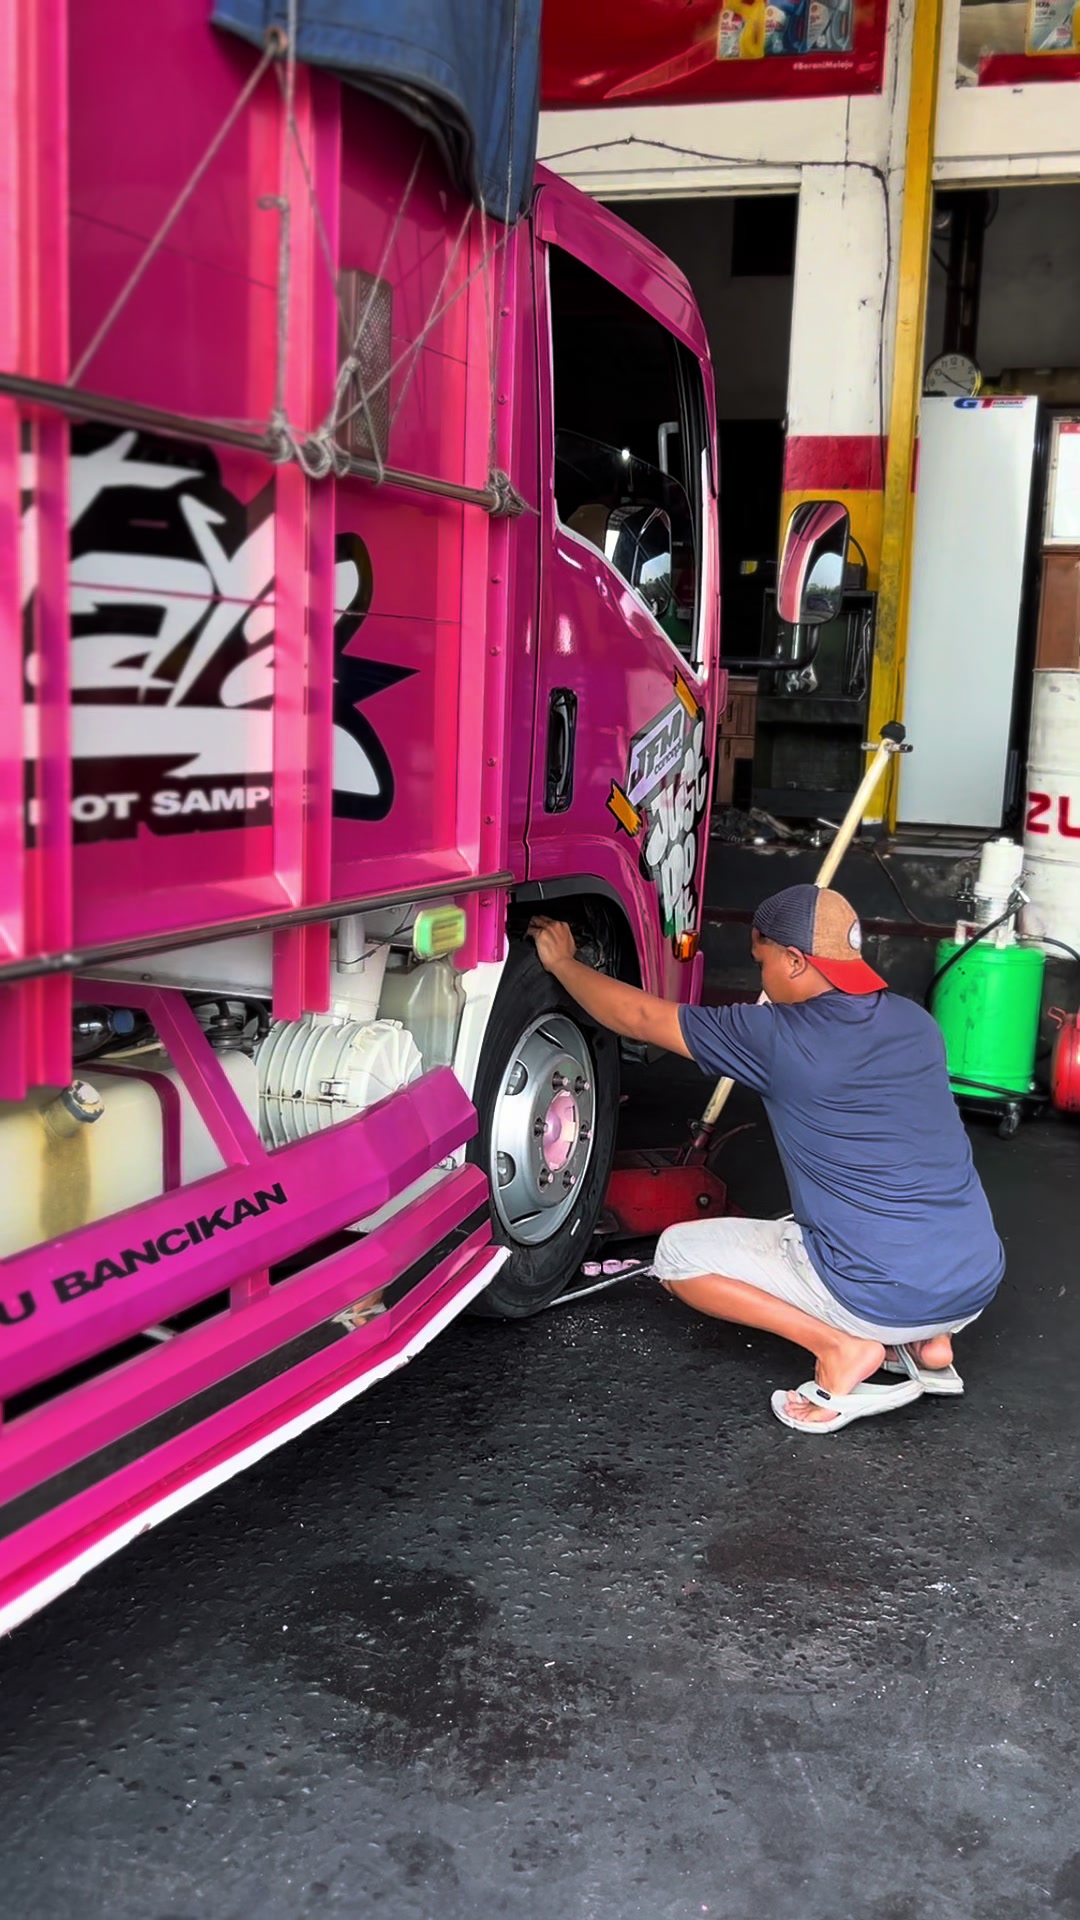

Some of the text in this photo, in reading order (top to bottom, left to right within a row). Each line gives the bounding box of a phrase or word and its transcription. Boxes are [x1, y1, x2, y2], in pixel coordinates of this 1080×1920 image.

[630, 709, 683, 788] JFM
[654, 738, 683, 775] concept
[51, 1182, 288, 1304] BANCIKAN
